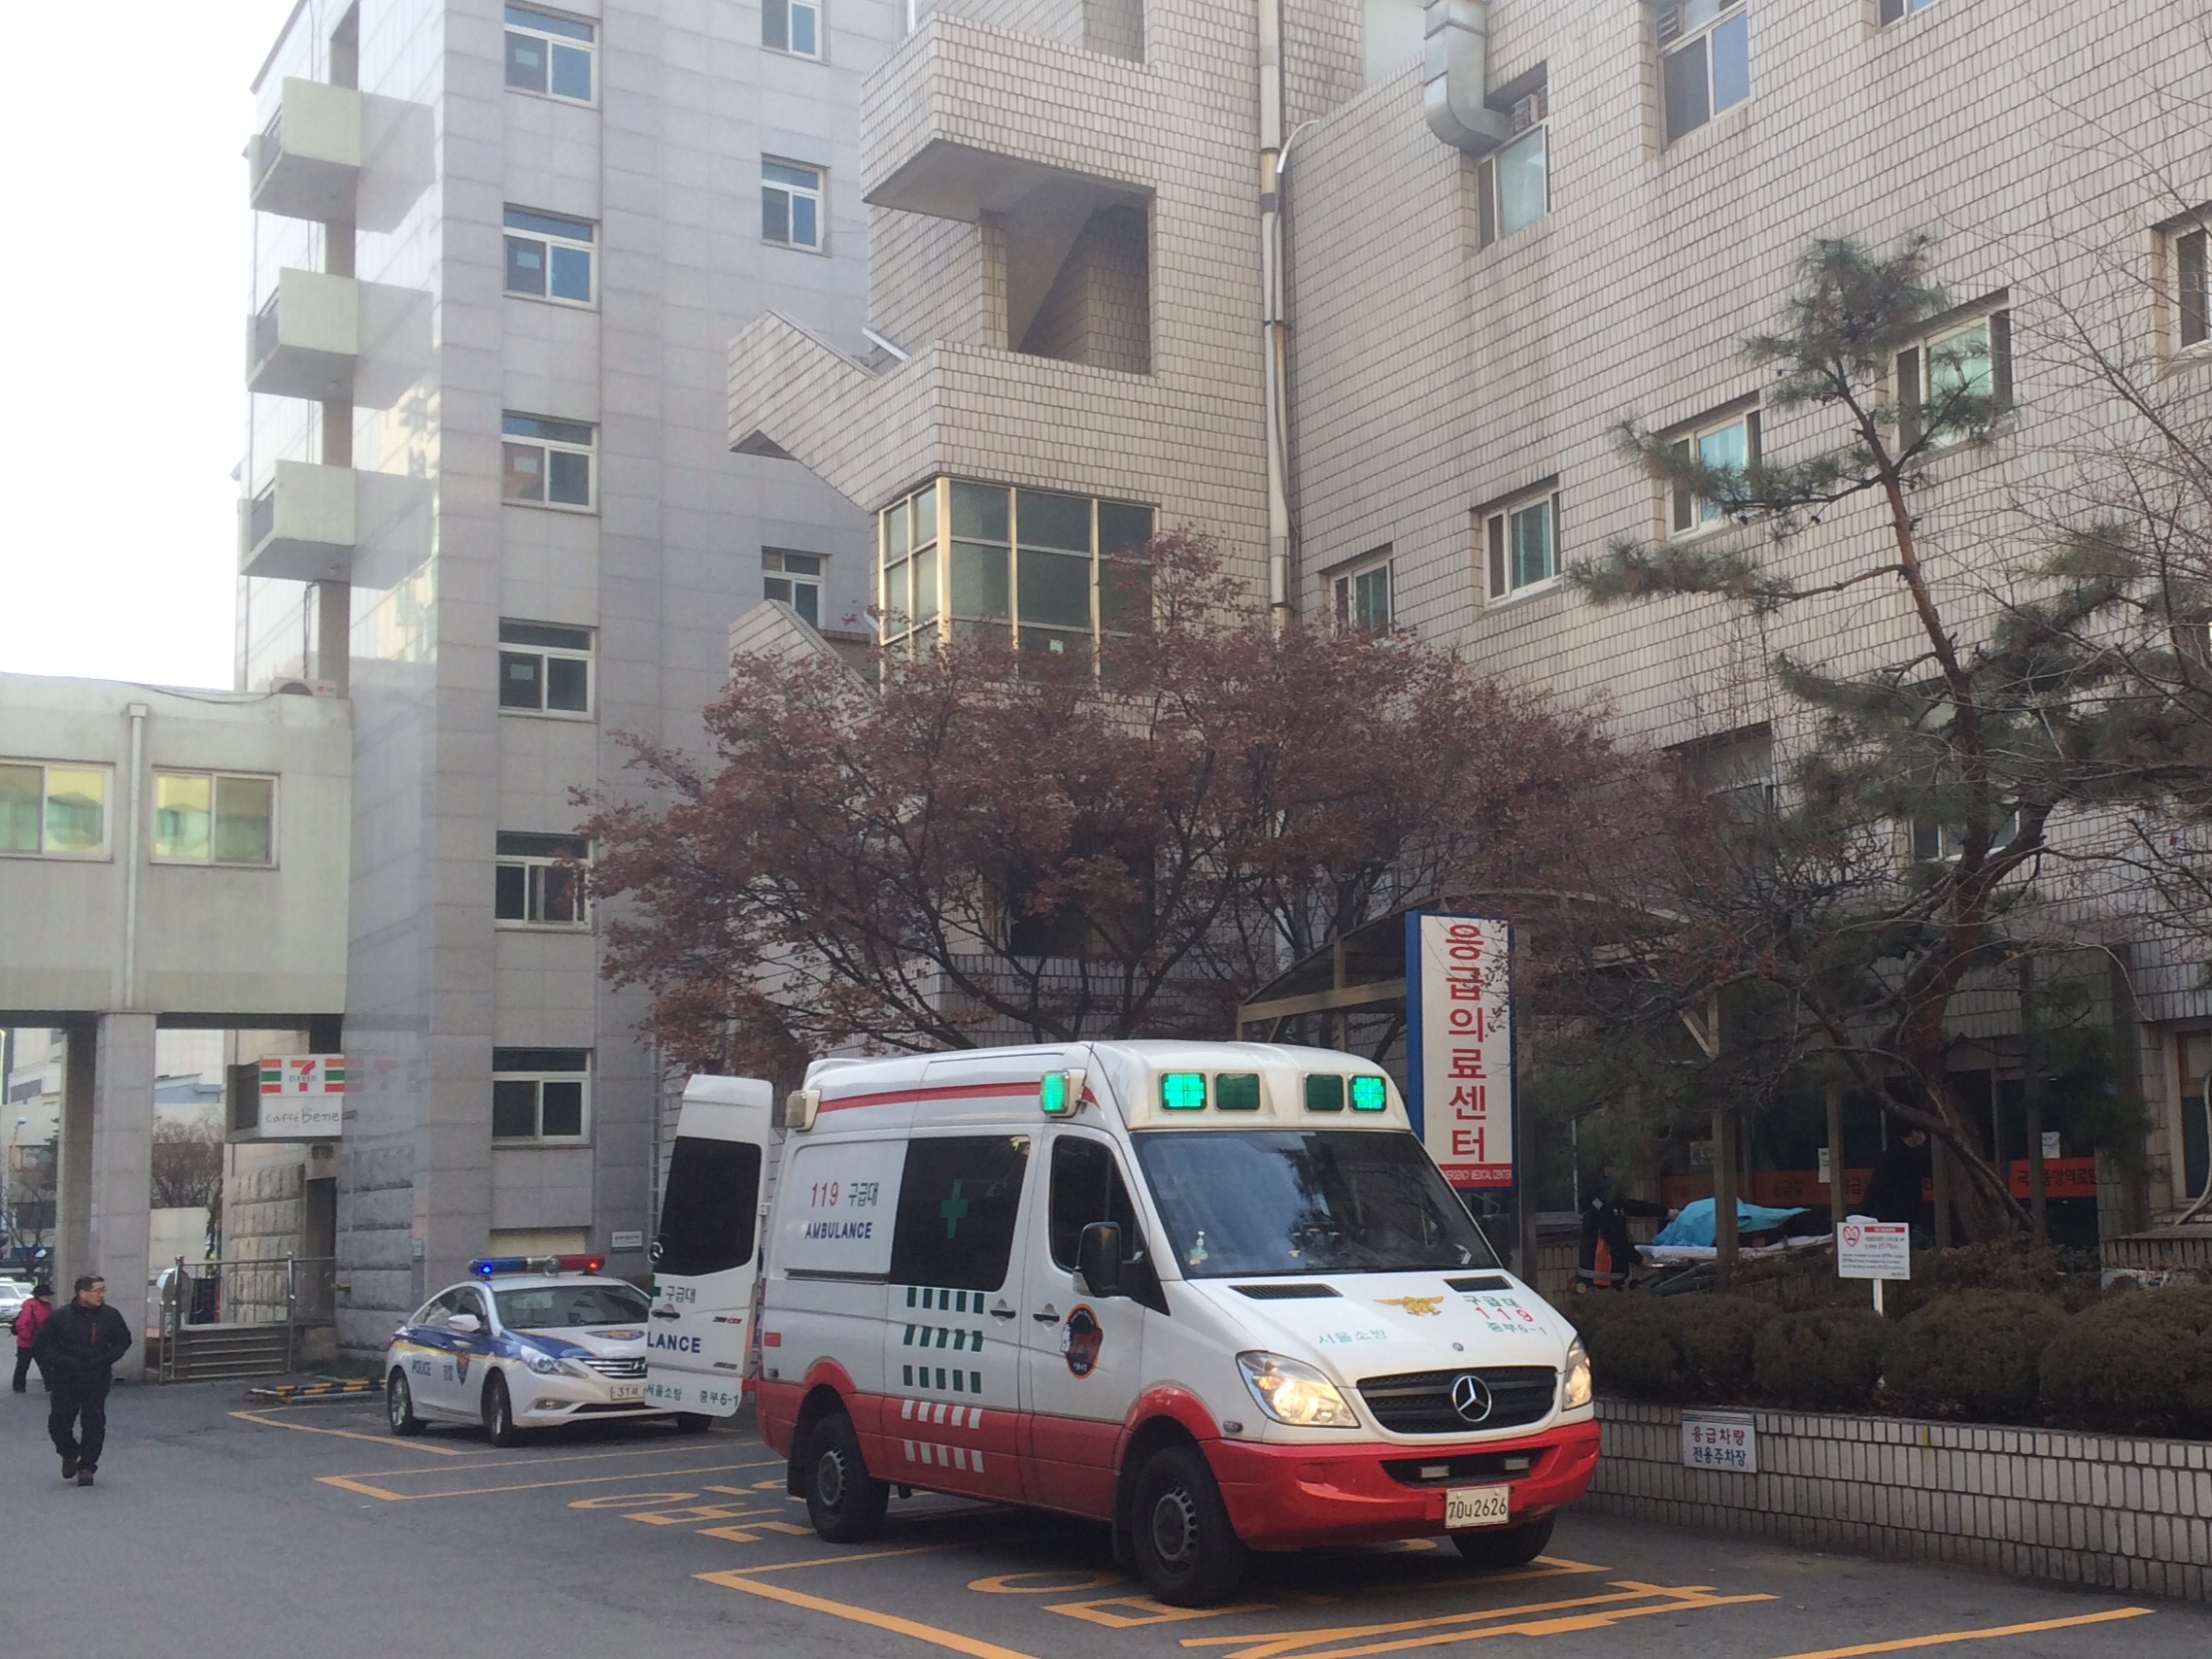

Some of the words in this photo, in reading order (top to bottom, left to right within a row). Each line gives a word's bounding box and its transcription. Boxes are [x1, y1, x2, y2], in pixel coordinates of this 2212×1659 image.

[1445, 924, 1487, 1163] 응급의료센터
[289, 1060, 316, 1092] 7
[811, 1181, 839, 1207] 119
[848, 1182, 879, 1207] 구급대
[804, 1222, 873, 1239] AMBULANCE
[665, 1285, 697, 1304] 구급대
[1462, 1295, 1522, 1309] 구급대
[1475, 1306, 1534, 1323] 119
[1317, 1328, 1388, 1345] 서울소방
[1691, 1425, 1746, 1446] 응급차량
[1692, 1445, 1747, 1468] 전용주차장
